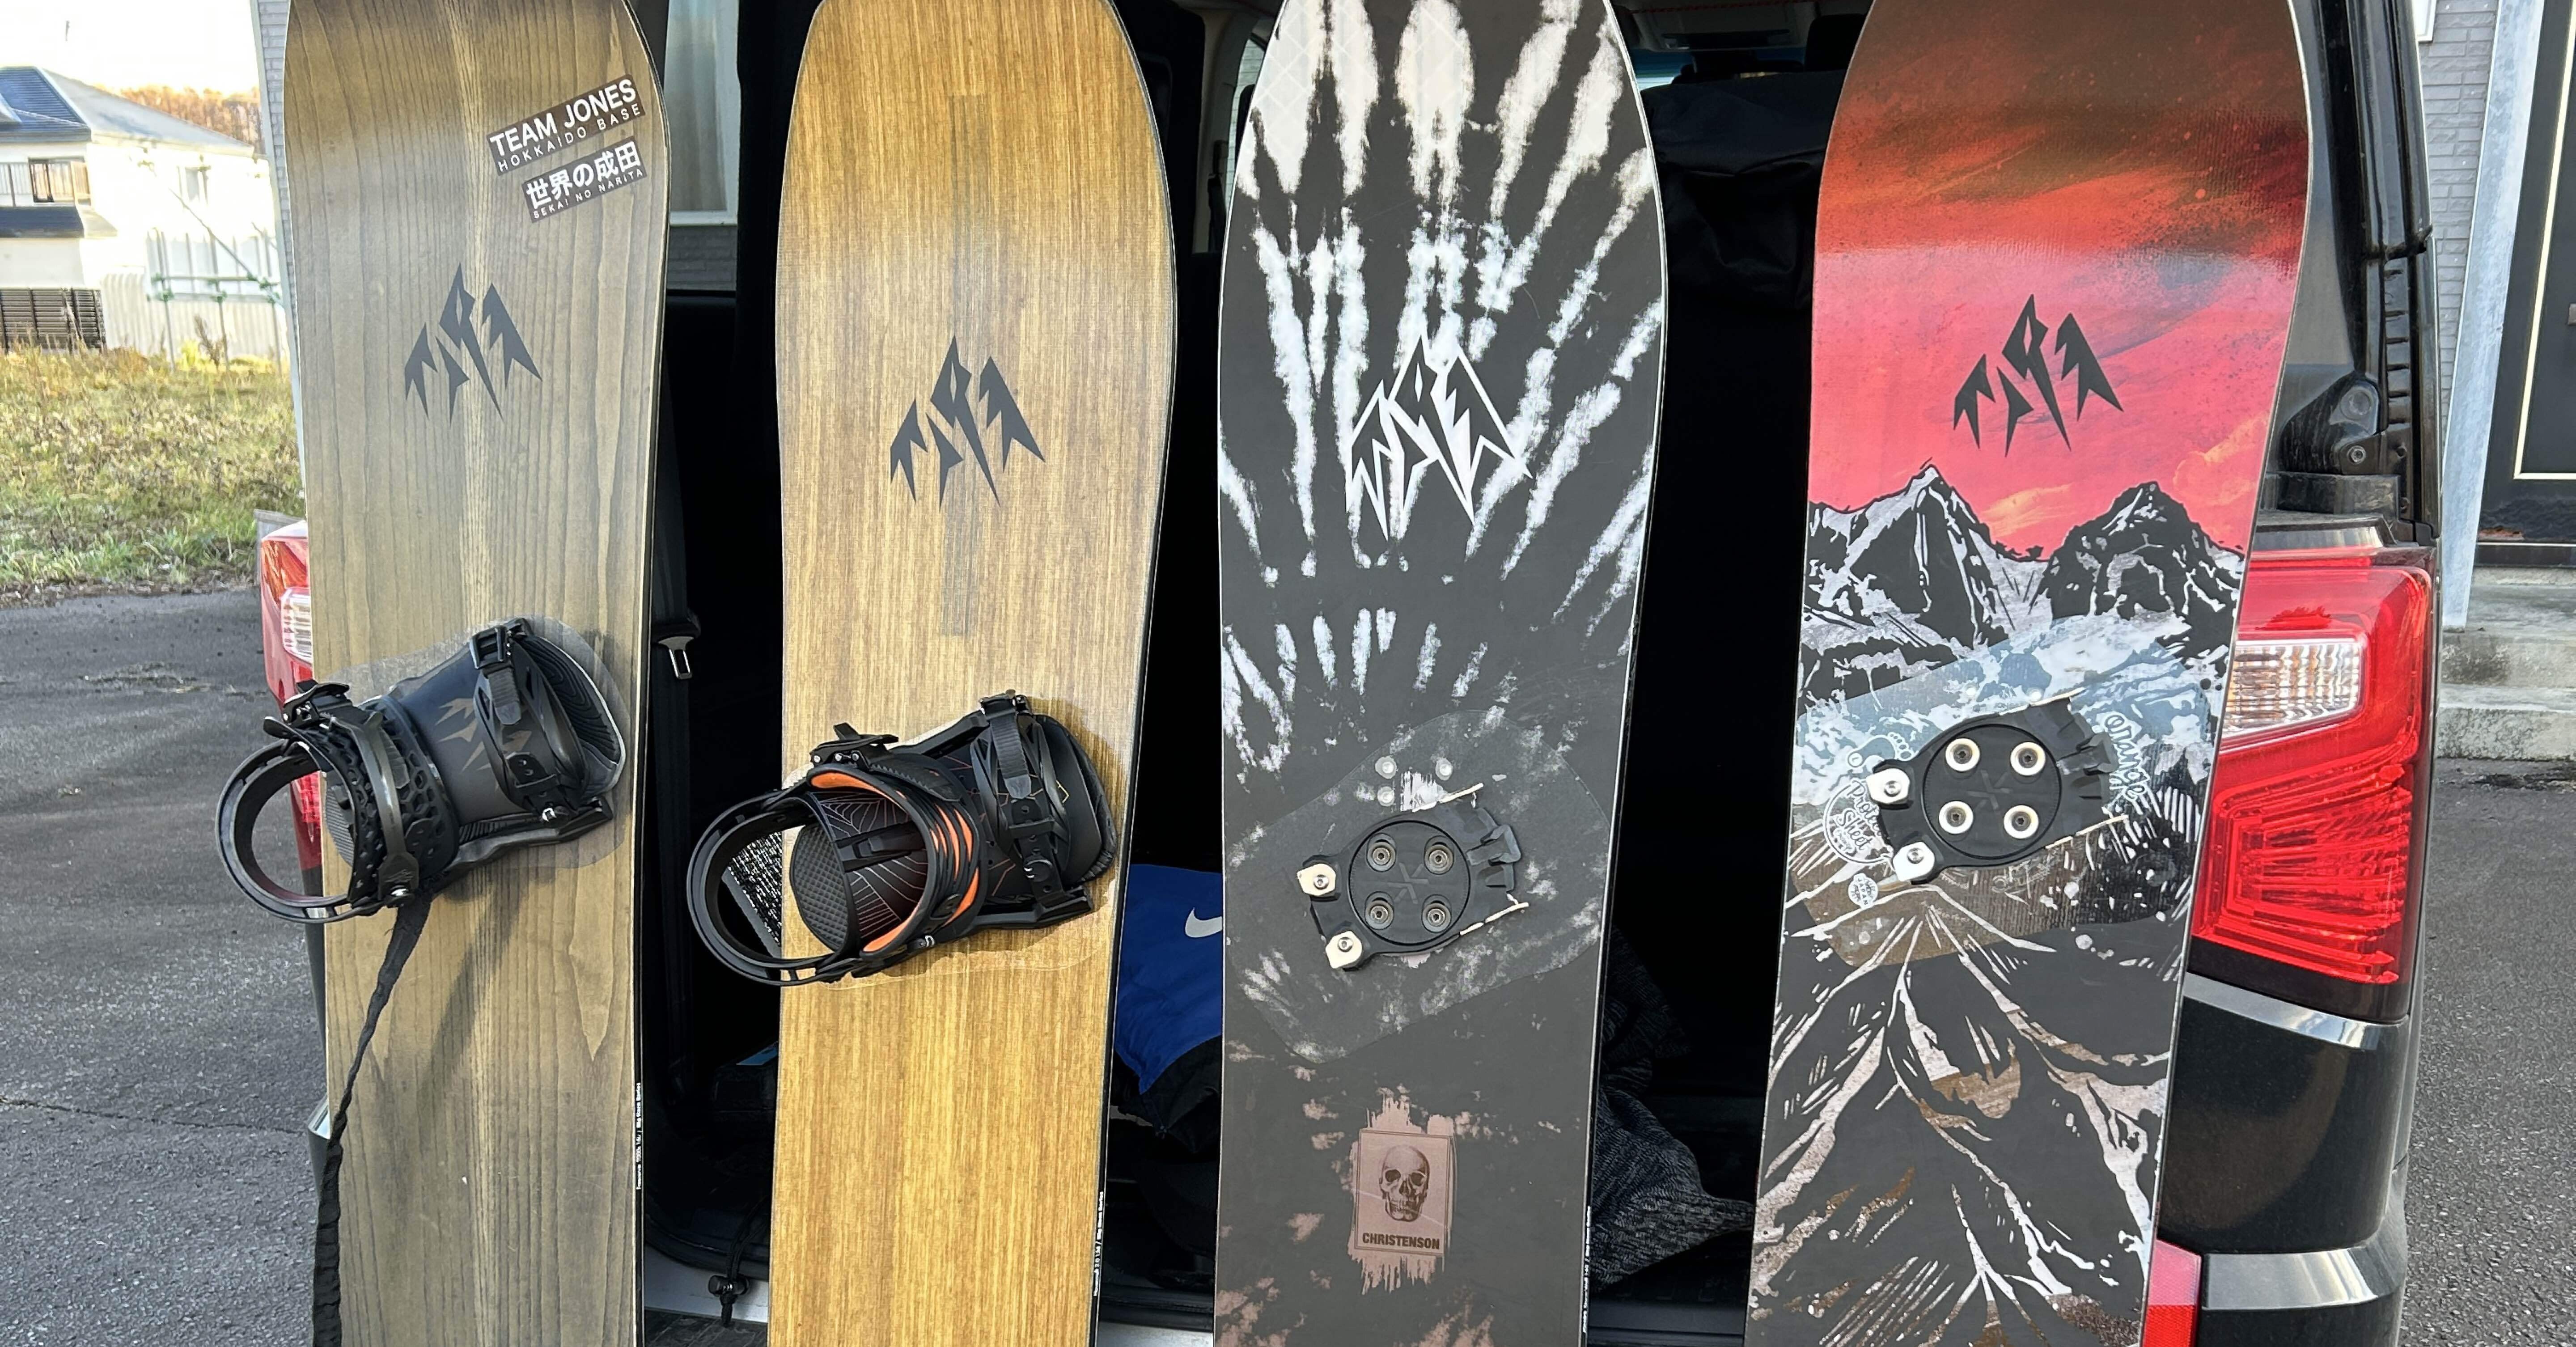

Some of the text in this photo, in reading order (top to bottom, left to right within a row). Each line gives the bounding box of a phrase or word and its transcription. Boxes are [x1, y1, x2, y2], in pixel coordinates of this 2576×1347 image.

[489, 79, 636, 157] TEAM JONES
[498, 104, 640, 172] HOKKAIDO BASE
[526, 141, 641, 209] 世界の成田
[534, 169, 644, 219] SEKAI NO NARITA
[1836, 810, 1873, 850] Sheet
[1362, 1233, 1440, 1250] CHRISTENSON
